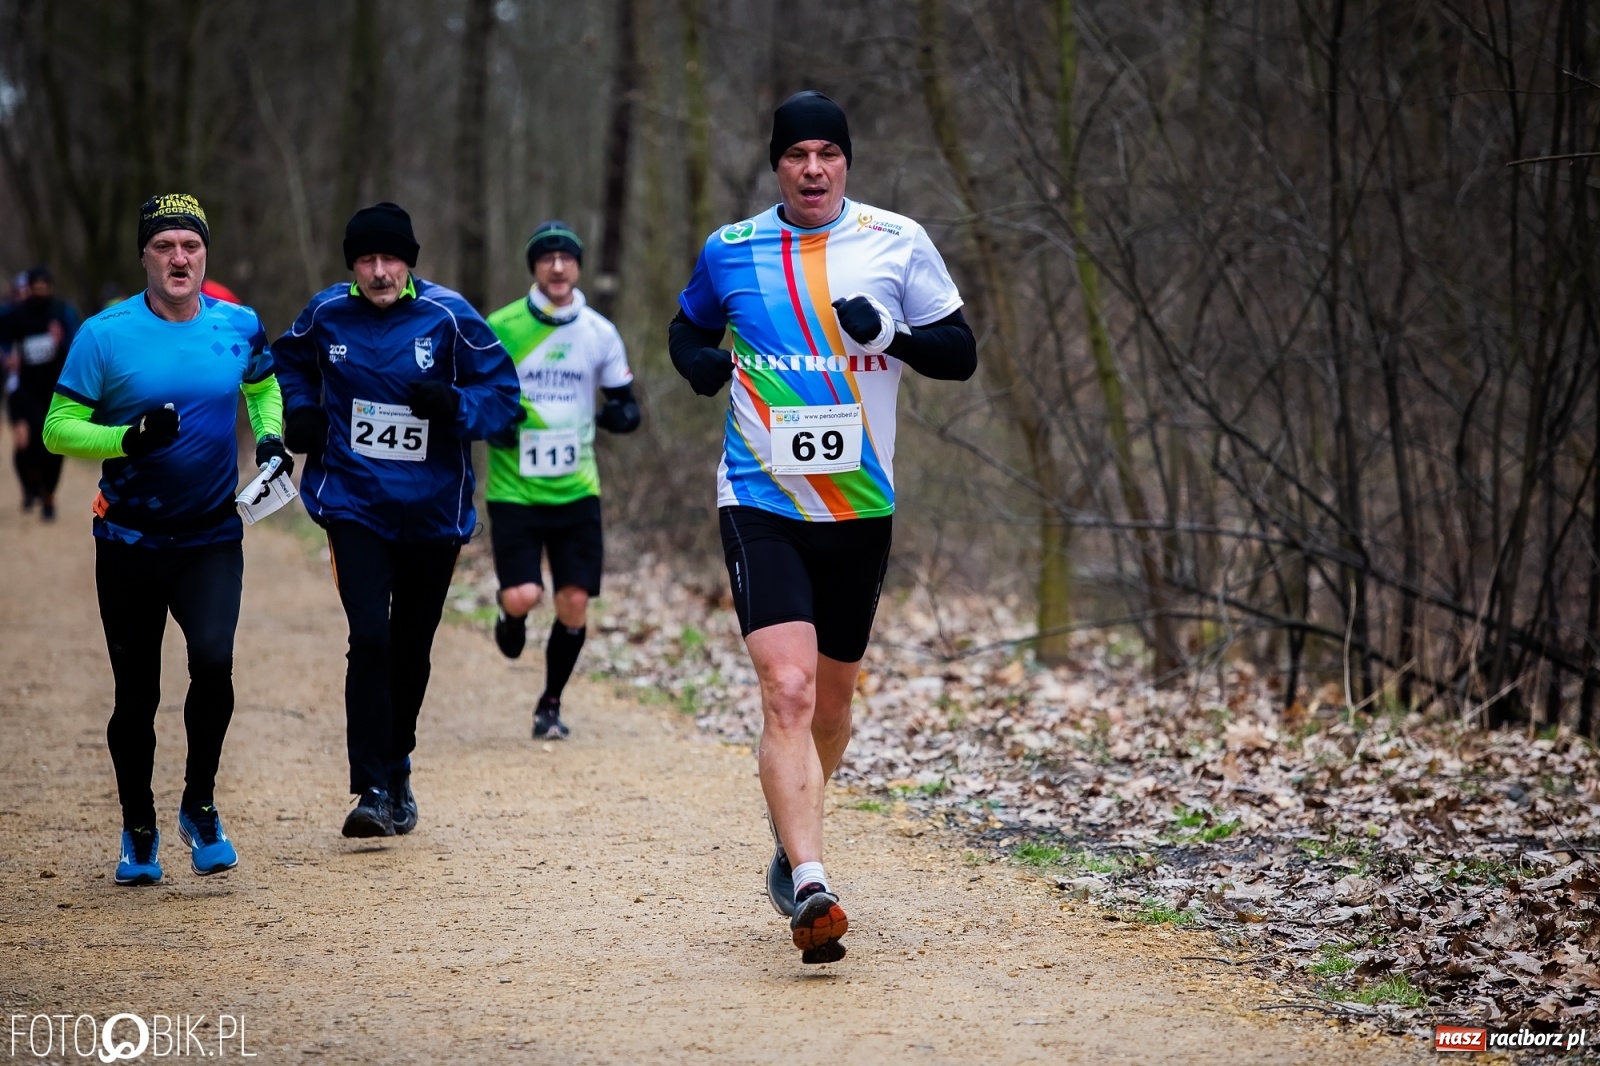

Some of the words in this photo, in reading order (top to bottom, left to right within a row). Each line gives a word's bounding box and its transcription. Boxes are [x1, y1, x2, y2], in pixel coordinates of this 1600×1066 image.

[355, 421, 423, 451] 245
[792, 430, 844, 462] 69
[526, 445, 576, 466] 113
